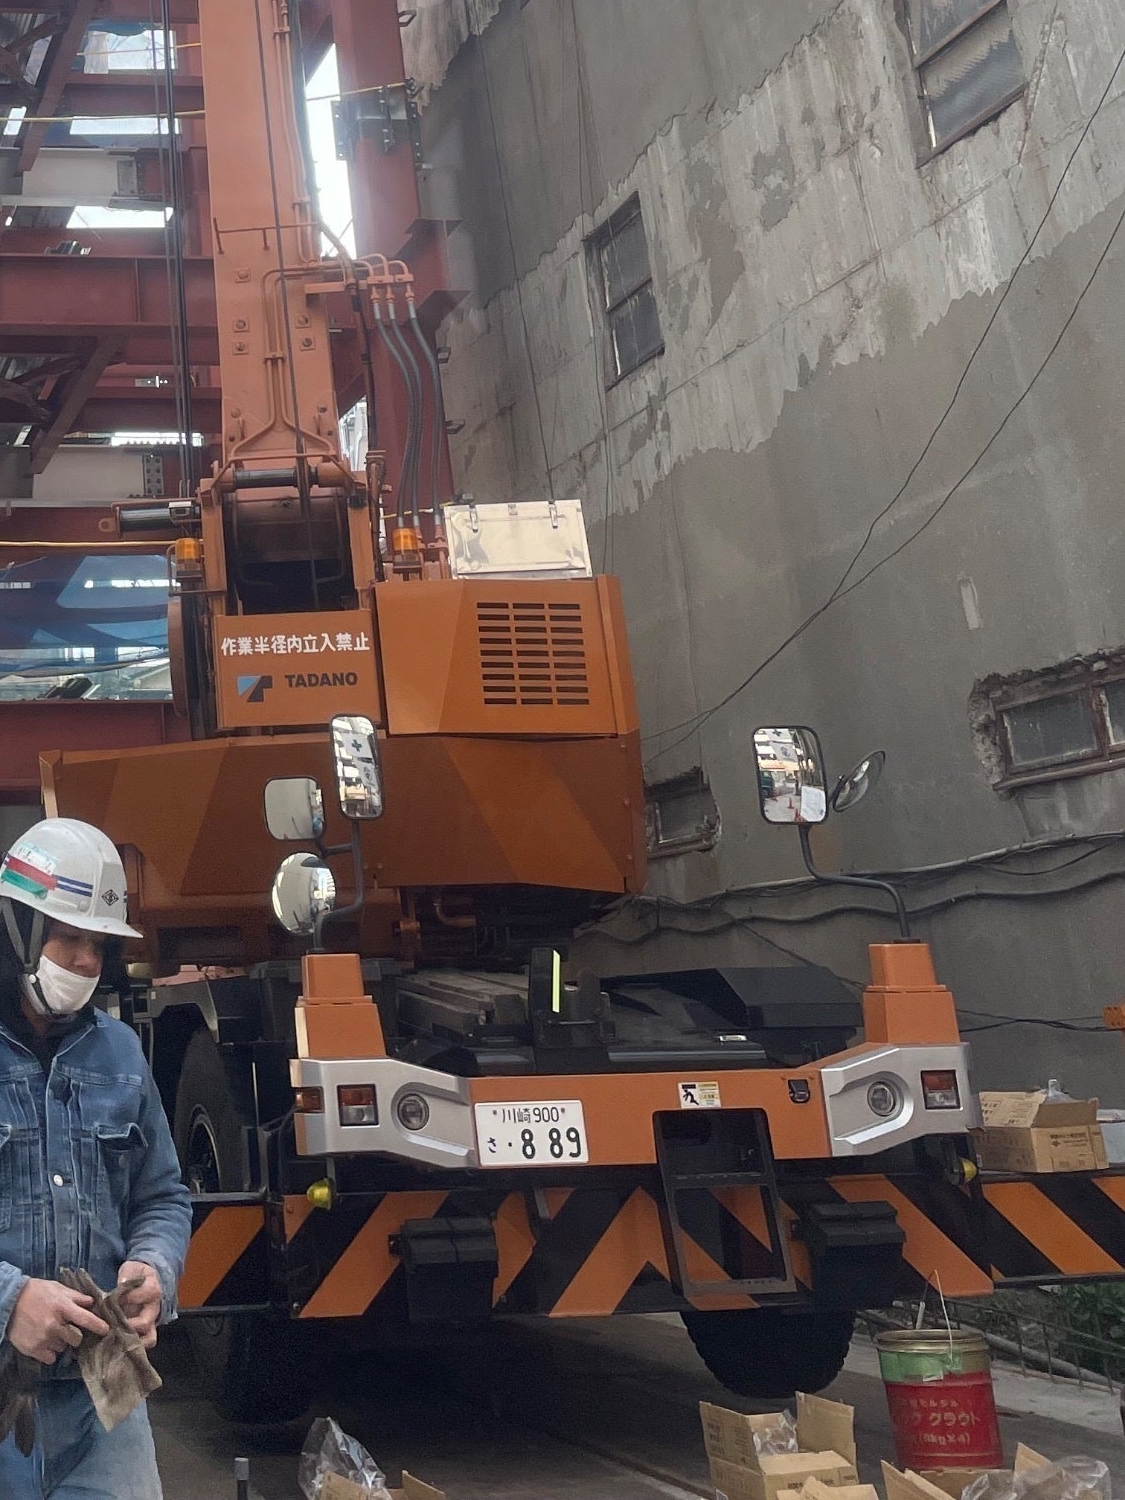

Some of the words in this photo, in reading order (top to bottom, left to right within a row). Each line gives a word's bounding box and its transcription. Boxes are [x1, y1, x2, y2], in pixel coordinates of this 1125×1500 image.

[220, 631, 371, 657] 作業半径内立入禁止
[284, 672, 359, 688] TADANO
